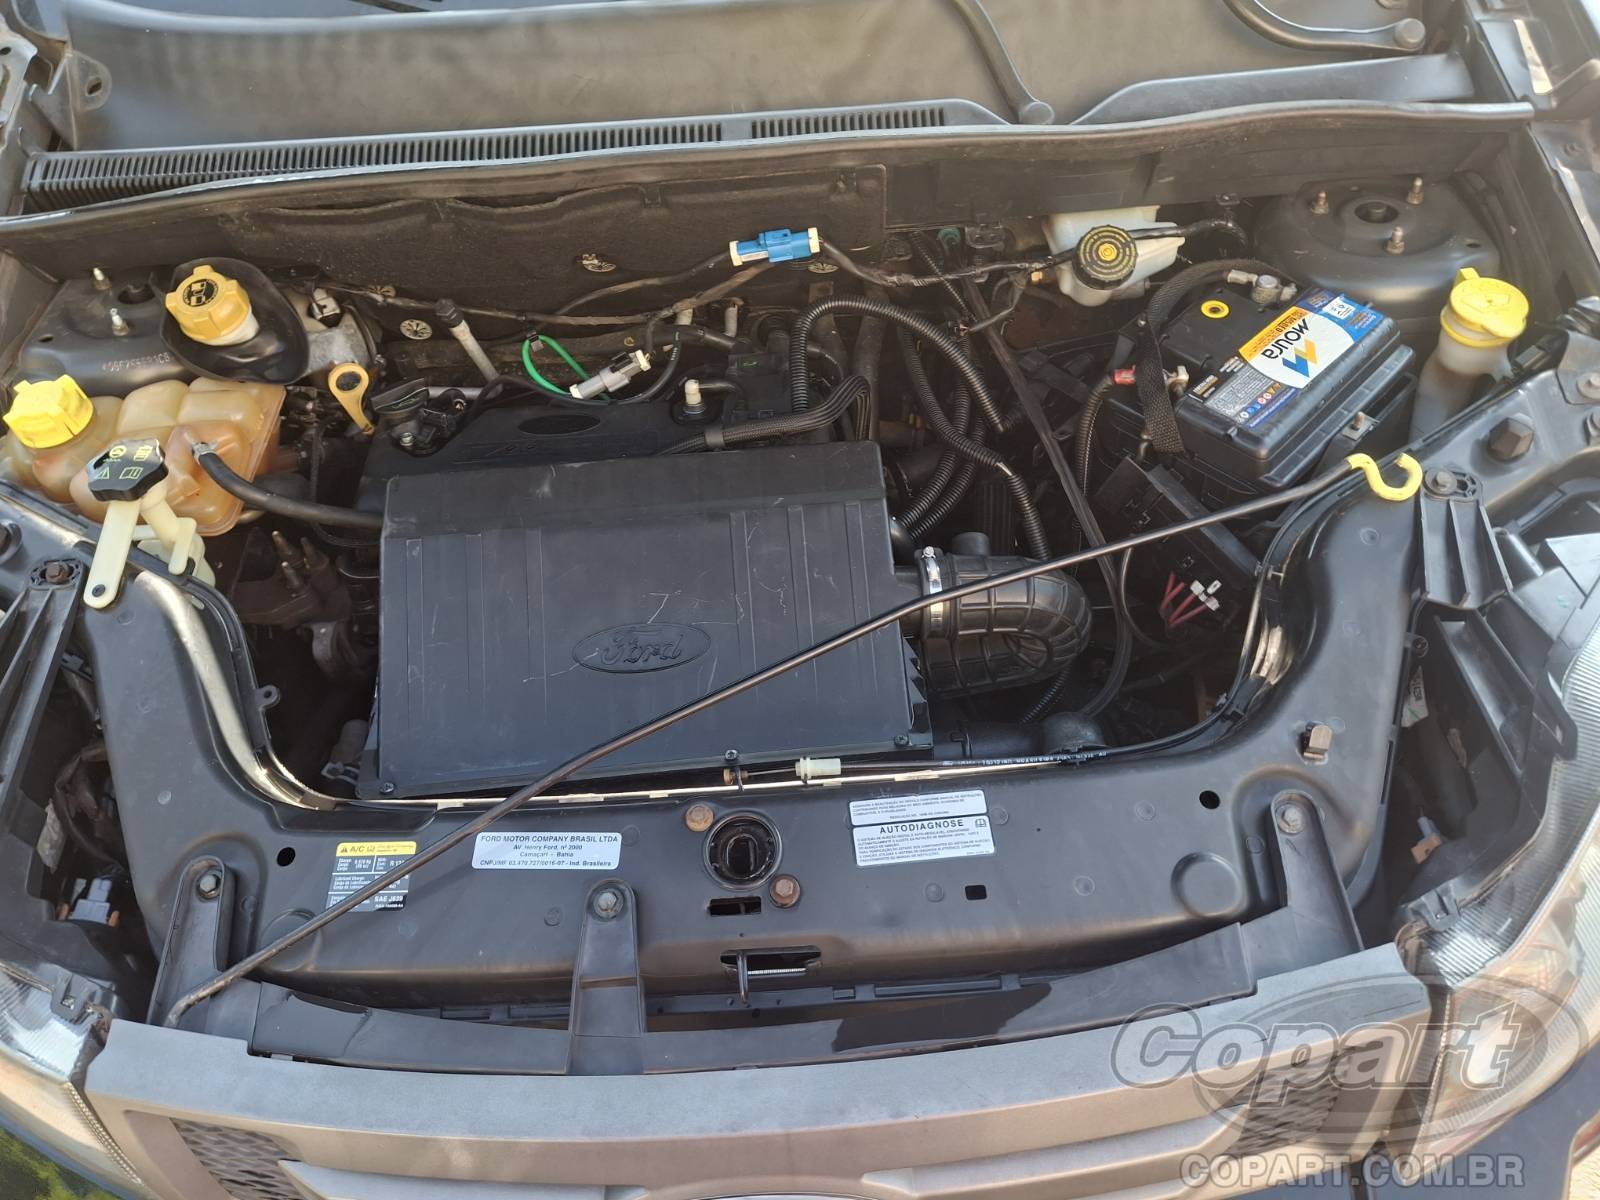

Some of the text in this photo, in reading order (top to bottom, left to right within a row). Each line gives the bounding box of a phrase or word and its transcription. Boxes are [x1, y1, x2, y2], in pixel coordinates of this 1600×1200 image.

[600, 631, 684, 666] Ford
[880, 819, 964, 834] AUTODIAGNOSE
[481, 835, 501, 843] FORD
[503, 835, 530, 843] MOTOR
[532, 835, 568, 843] COMPANY
[570, 835, 597, 843] BRASIL
